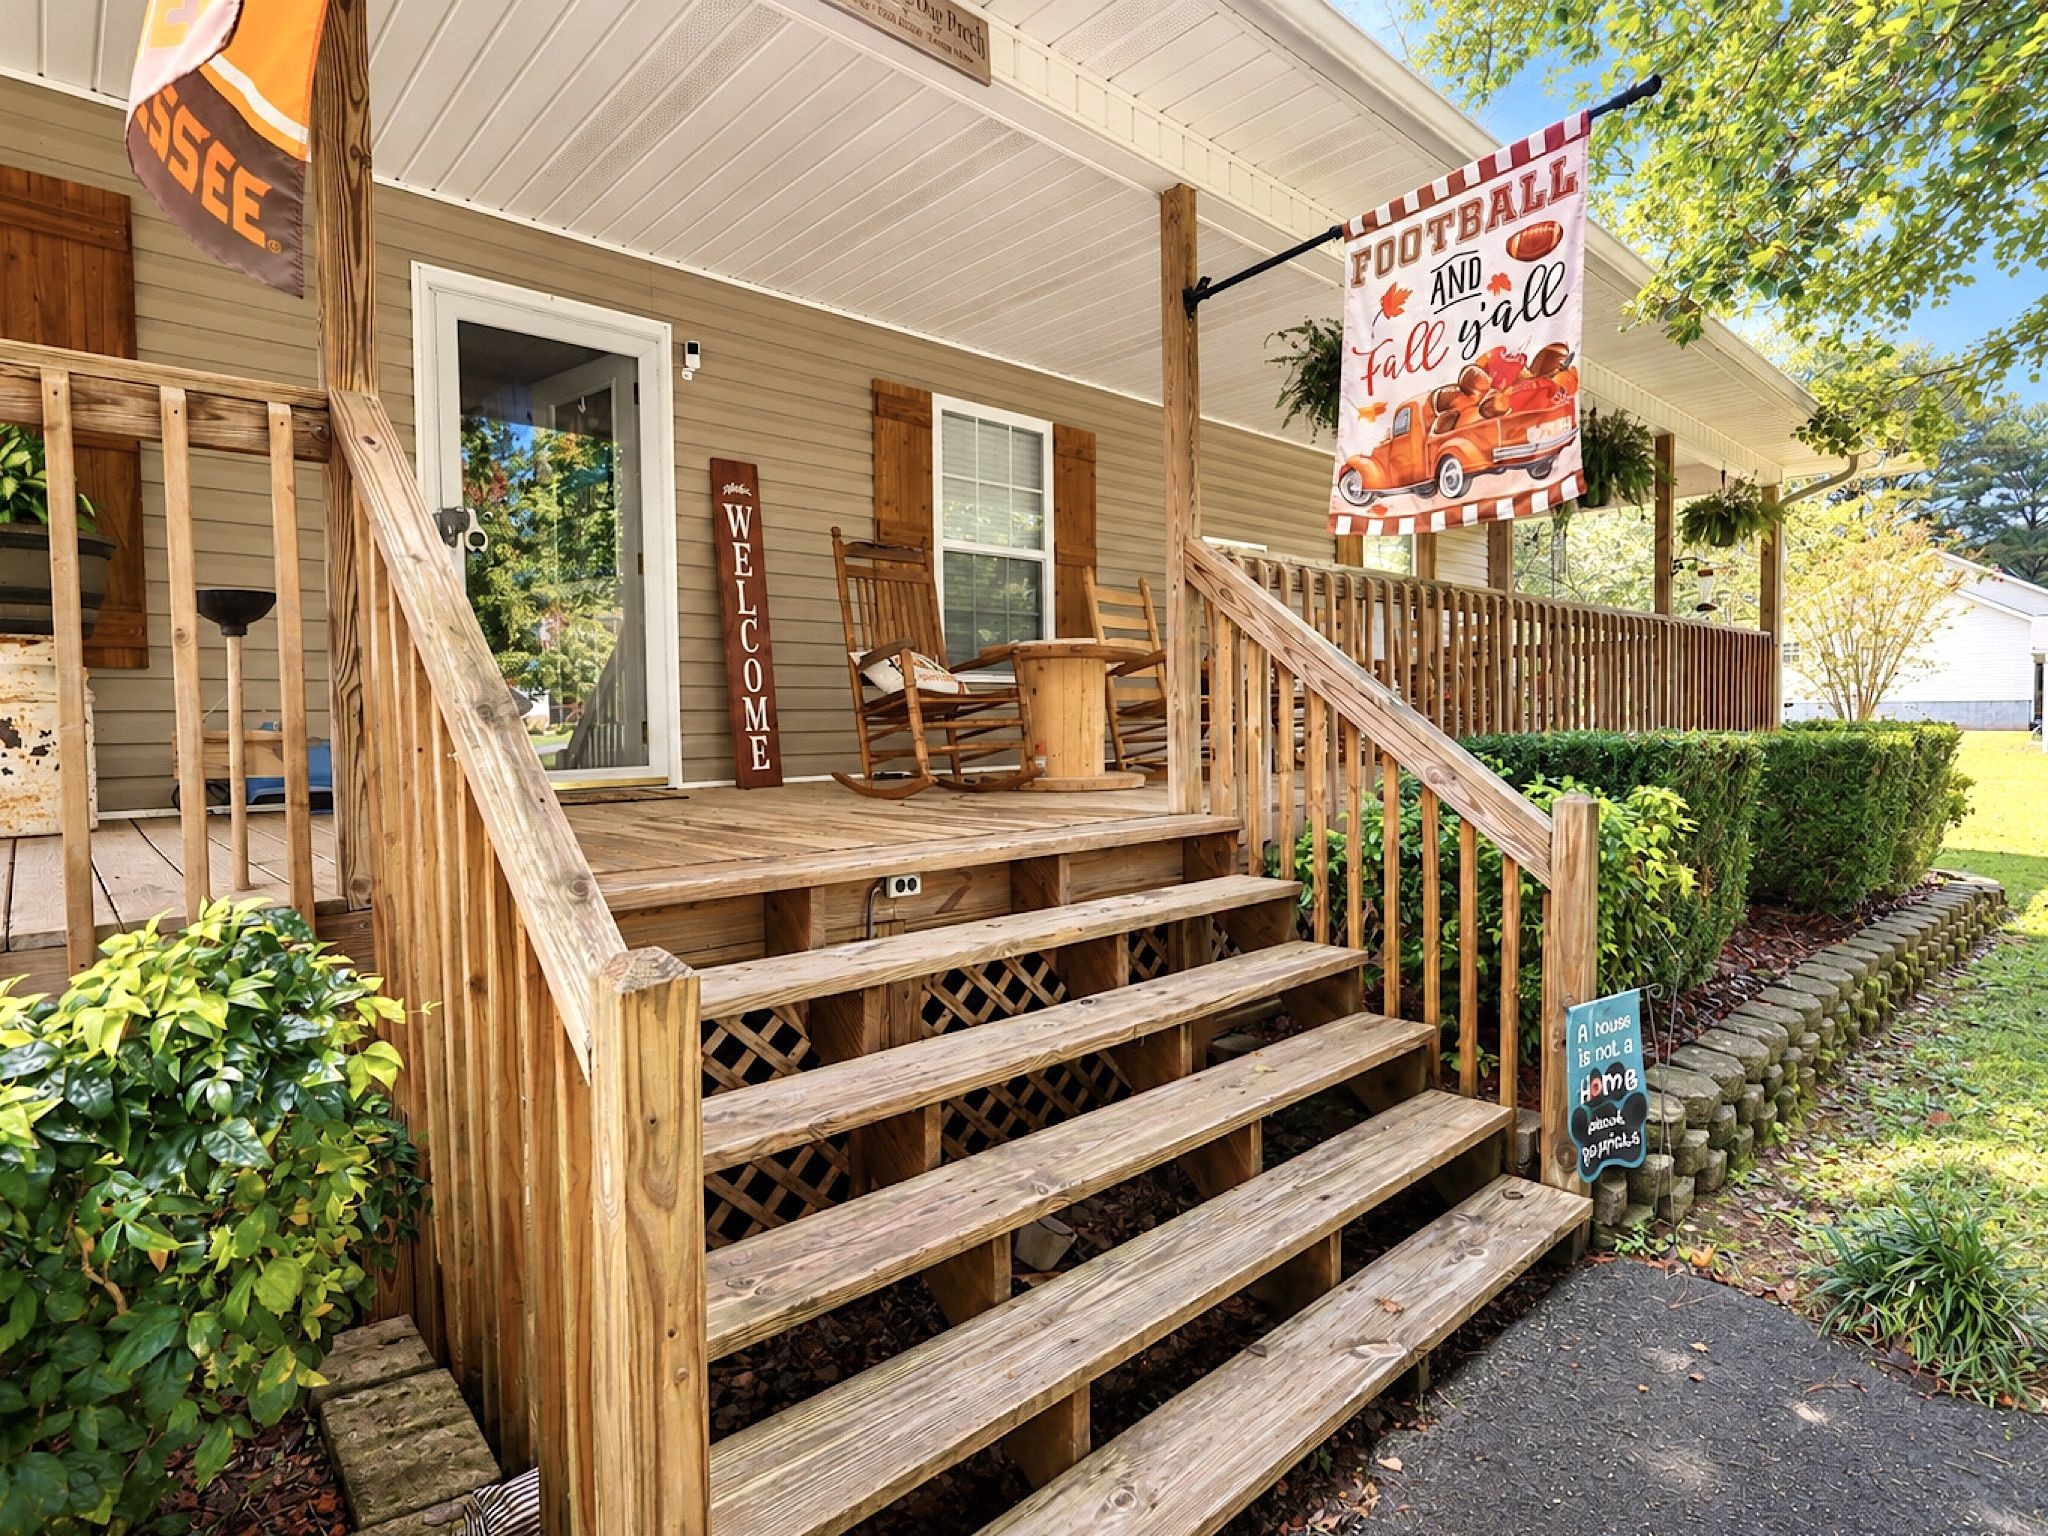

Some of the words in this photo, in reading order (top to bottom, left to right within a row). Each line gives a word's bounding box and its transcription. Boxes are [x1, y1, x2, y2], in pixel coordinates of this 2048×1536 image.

[1350, 156, 1579, 289] FOOTBALL
[1430, 256, 1482, 306] AND
[1352, 320, 1450, 396] Fall
[1458, 260, 1569, 361] y'all
[722, 502, 771, 771] WELCOME
[1577, 1023, 1588, 1044] A
[1577, 1047, 1591, 1068] is
[1623, 1038, 1633, 1054] a
